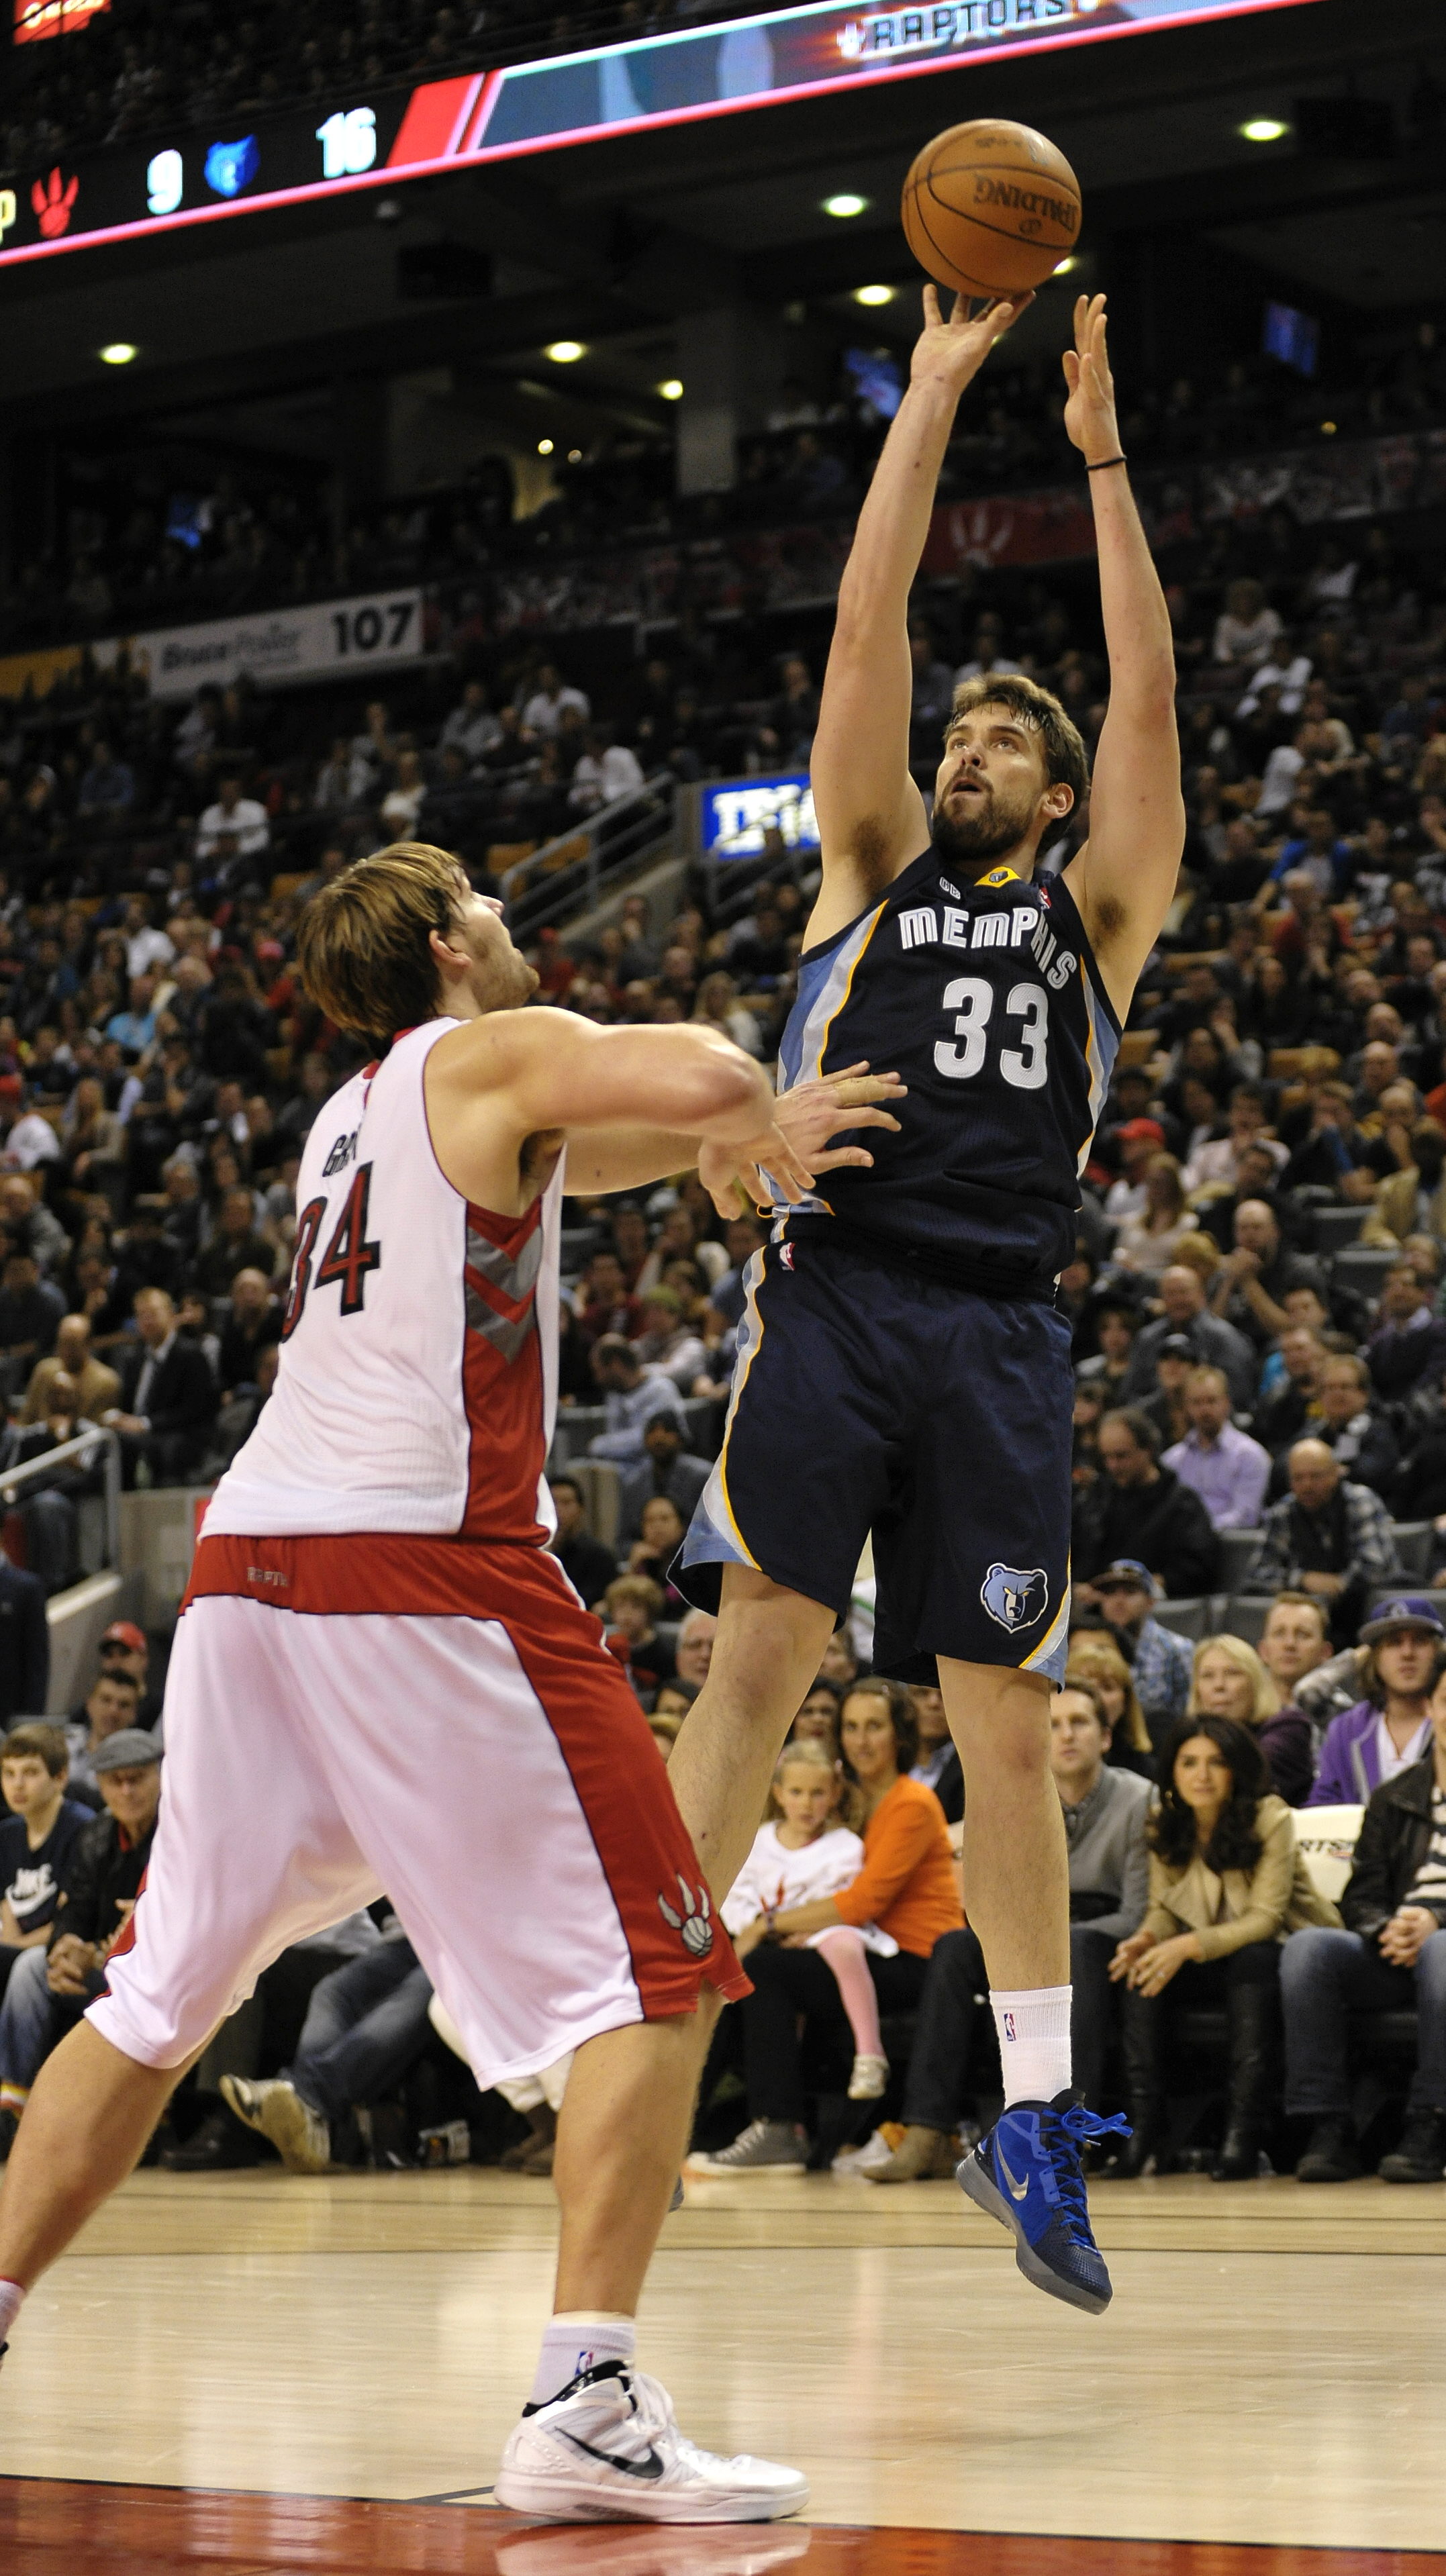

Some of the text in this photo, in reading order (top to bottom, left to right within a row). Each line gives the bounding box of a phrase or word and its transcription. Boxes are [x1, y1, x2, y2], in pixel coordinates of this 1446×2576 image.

[863, 0, 1073, 56] RAPTORS
[146, 148, 183, 215] 9
[315, 106, 377, 179] 16
[332, 604, 416, 656] 107
[898, 906, 1077, 990] MEMPHIS
[934, 977, 1049, 1089] 33
